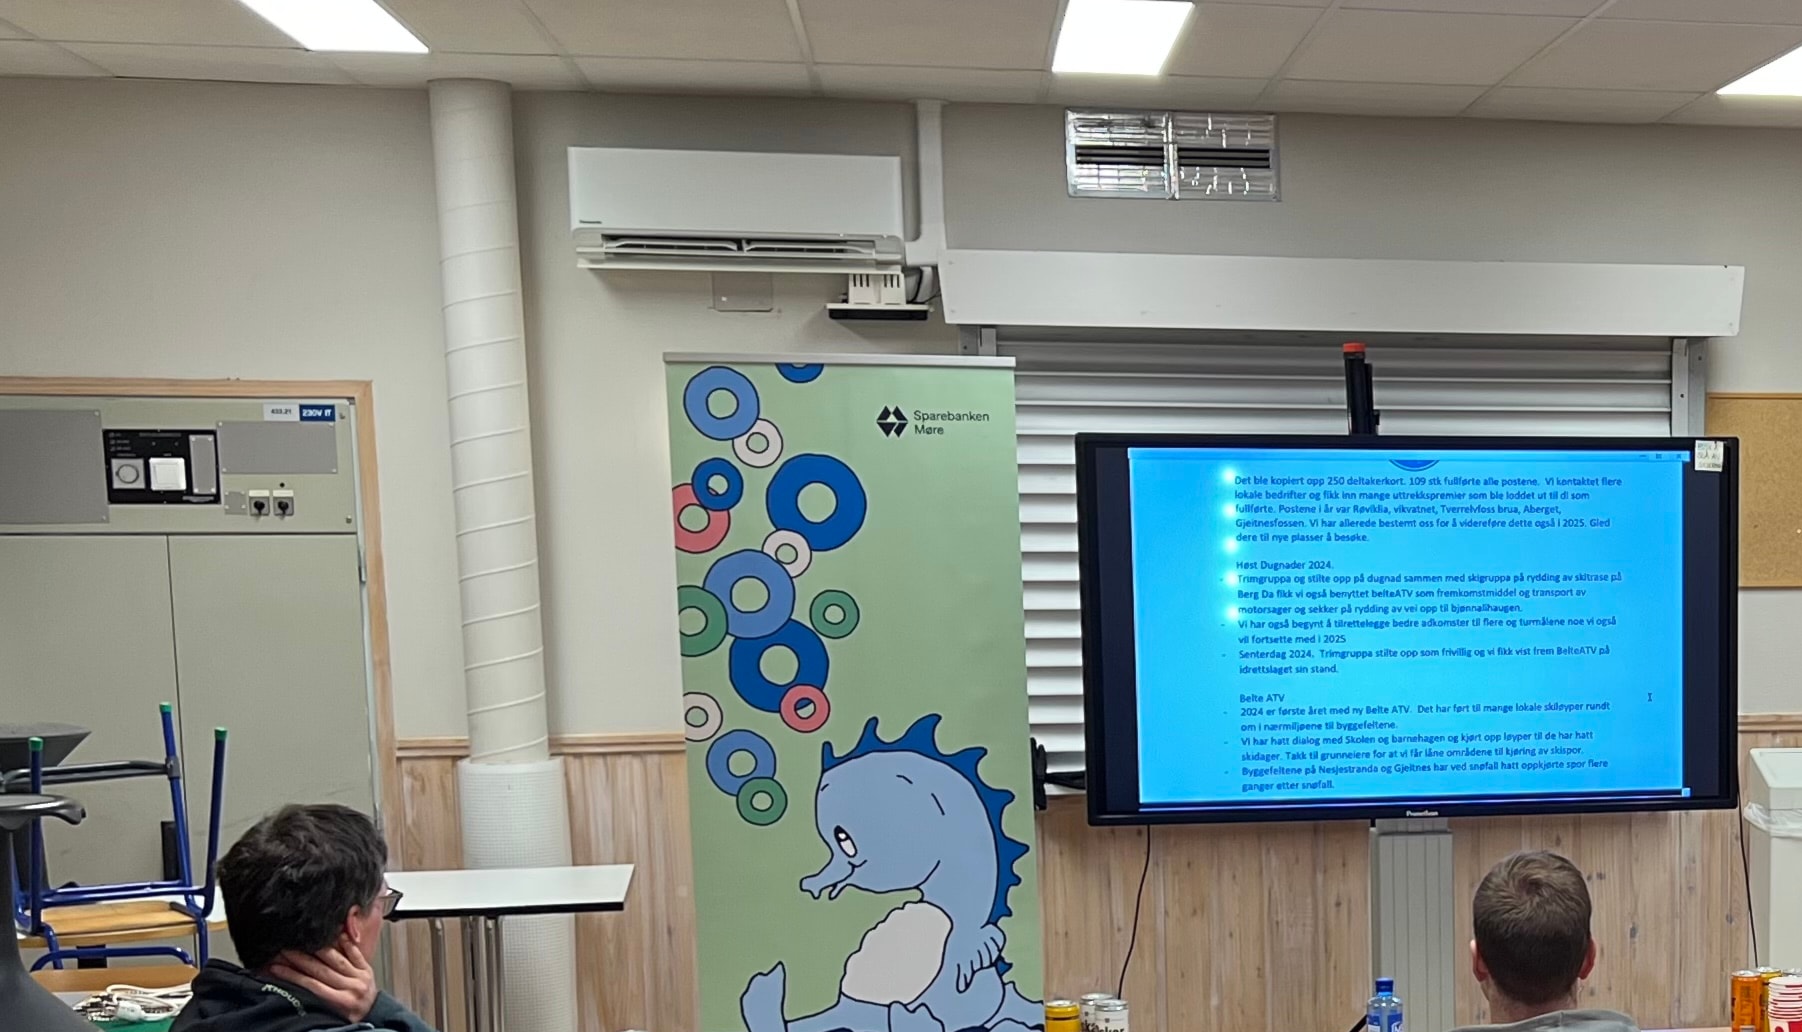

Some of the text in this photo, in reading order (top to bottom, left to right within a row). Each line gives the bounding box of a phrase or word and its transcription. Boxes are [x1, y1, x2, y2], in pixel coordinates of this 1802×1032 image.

[913, 410, 990, 423] Sparebanken
[914, 424, 944, 435] Møre
[1235, 476, 1251, 485] Det
[1271, 476, 1304, 486] kopiert
[1327, 476, 1345, 485] 250
[1409, 476, 1426, 485] 109
[1444, 477, 1481, 486] fullførte
[1483, 476, 1499, 485] alle
[1556, 477, 1599, 486] kontaktet
[1601, 477, 1622, 486] flere
[1235, 490, 1263, 499] lokale
[1265, 490, 1307, 499] bedrifter
[1323, 490, 1339, 499] fikk
[1359, 492, 1390, 501] mange
[1506, 491, 1535, 500] loddet
[1279, 504, 1316, 513] Postene
[1339, 518, 1376, 527] allerede
[1379, 518, 1416, 527] bestemt
[1459, 518, 1506, 527] videreføre
[1508, 518, 1532, 527] dette
[1535, 518, 1555, 529] også
[1236, 532, 1257, 541] dere
[1291, 533, 1323, 542] plasser
[1236, 561, 1258, 570] Høst
[1260, 561, 1305, 571] Dugnader
[1308, 574, 1331, 583] stilte
[1367, 574, 1401, 584] dugnad
[1404, 575, 1442, 583] sammen
[1445, 573, 1465, 582] med
[1468, 574, 1511, 583] skigruppa
[1527, 574, 1560, 583] rydding
[1238, 588, 1573, 600] Berg fikk også benyttet belteATV fremkomstmiddel transport
[1238, 606, 1292, 615] motorsager
[1308, 604, 1338, 613] sekker
[1355, 604, 1389, 615] rydding
[1268, 619, 1289, 630] også
[1292, 620, 1324, 630] begynt
[1334, 620, 1390, 629] tilrettelegge
[1392, 618, 1419, 627] bedre
[1483, 617, 1504, 626] flere
[1519, 617, 1565, 626] turmålene
[1596, 616, 1616, 627] også
[1251, 634, 1346, 644] fortsette med 2025
[1239, 650, 1286, 660] Senterdag
[1375, 648, 1398, 657] stilte
[1442, 648, 1472, 657] frivillig
[1497, 646, 1513, 655] fikk
[1515, 647, 1531, 656] vist
[1533, 646, 1554, 655] frem
[1557, 646, 1597, 655] BelteATV
[1239, 665, 1293, 675] idrettslaget
[1240, 693, 1285, 703] Belte ATV
[1241, 707, 1263, 716] 2024
[1278, 706, 1306, 715] første
[1308, 706, 1327, 715] året
[1329, 706, 1350, 715] med
[1366, 705, 1389, 714] Belte
[1417, 704, 1433, 713] Det
[1453, 704, 1469, 713] ført
[1483, 704, 1513, 713] mange
[1516, 702, 1542, 711] lokale
[1544, 702, 1583, 712] skiløyper
[1586, 701, 1610, 710] rundt
[1271, 730, 1593, 746] hatt dialog med Skolen barnehagen kjørt løyper hatt
[1285, 751, 1307, 760] Takk
[1320, 752, 1371, 761] grunneiere
[1425, 748, 1444, 757] låne
[1446, 748, 1492, 757] områdene
[1506, 747, 1536, 757] kjøring
[1242, 766, 1302, 777] Byggefeltene
[1469, 761, 1498, 770] snøfall
[1501, 760, 1519, 769] hatt
[1521, 761, 1564, 770] oppkjørte
[1567, 761, 1586, 770] spor
[1588, 758, 1608, 767] flere
[1242, 783, 1274, 792] ganger
[1276, 781, 1299, 790] etter
